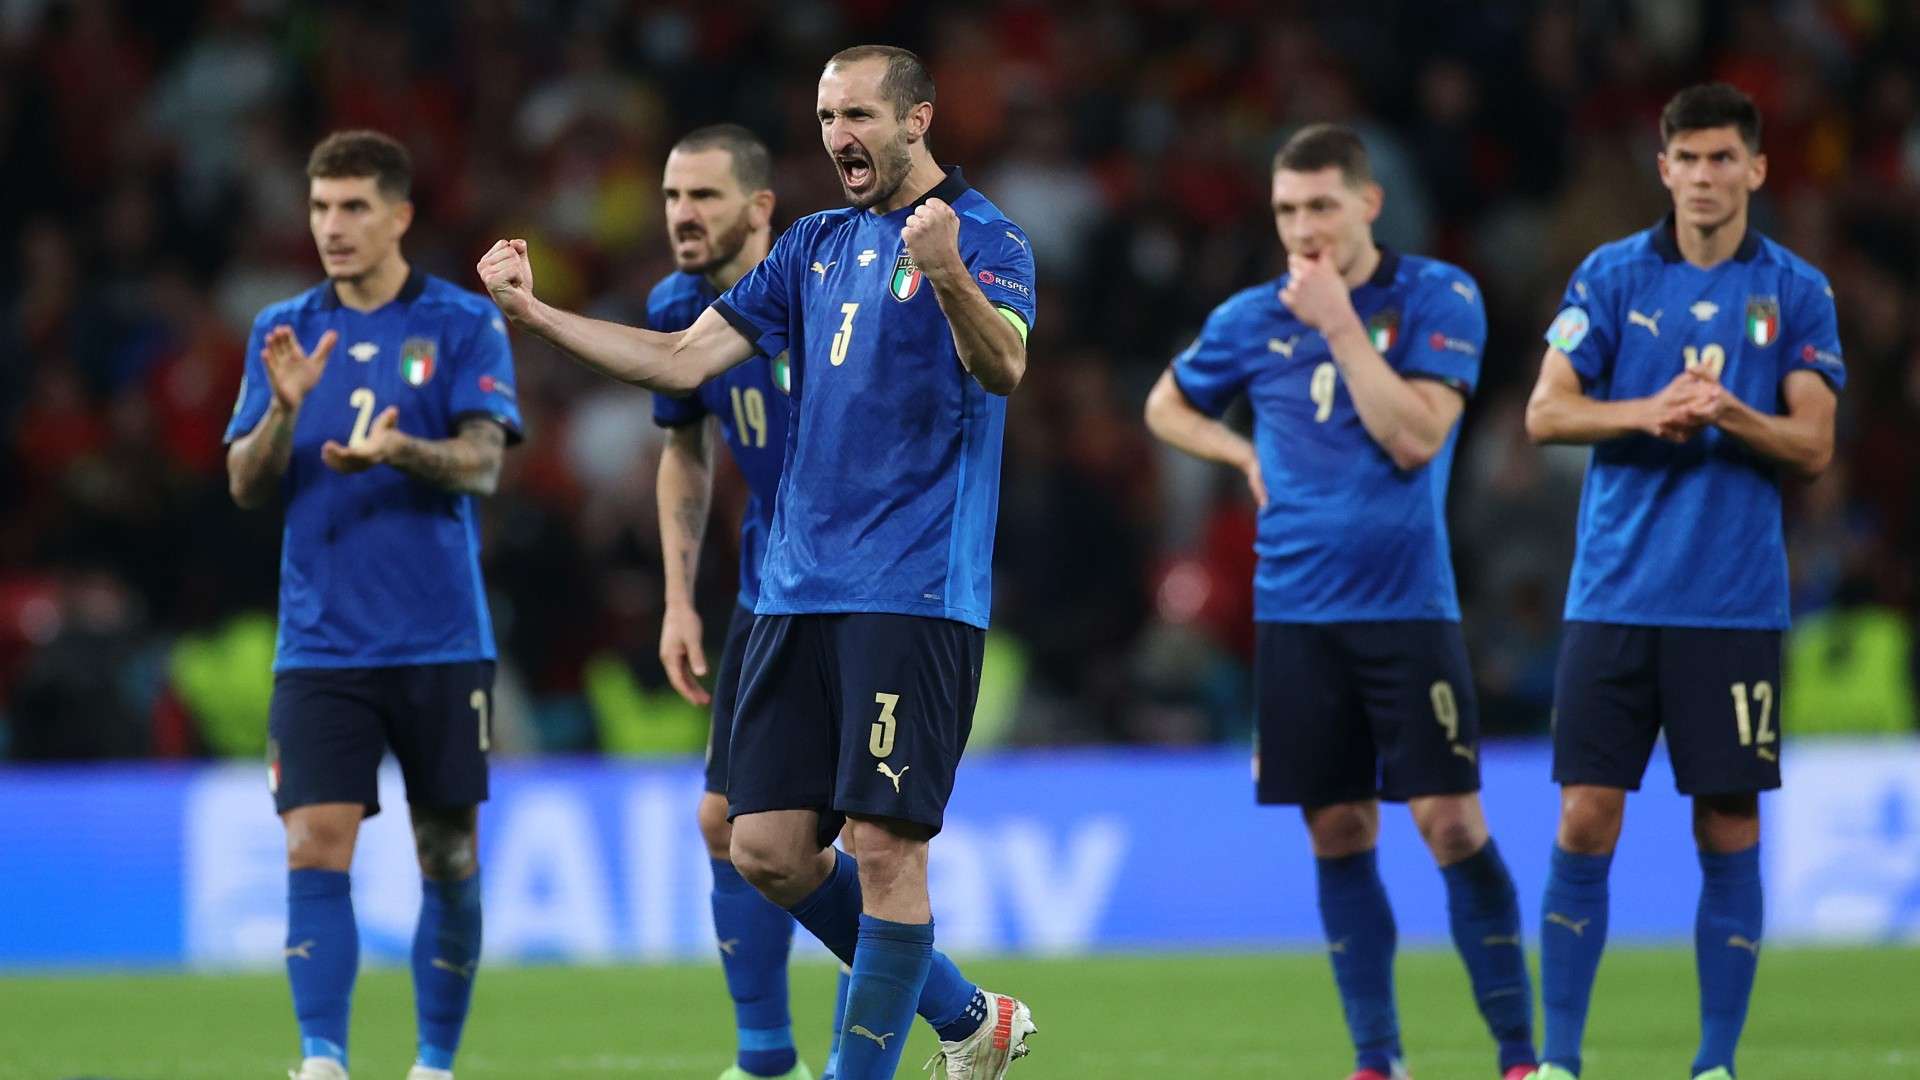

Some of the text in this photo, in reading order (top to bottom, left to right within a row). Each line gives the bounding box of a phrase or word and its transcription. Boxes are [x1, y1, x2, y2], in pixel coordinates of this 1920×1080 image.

[995, 277, 1030, 297] RESPEC
[830, 302, 860, 367] 3
[348, 387, 375, 449] 2
[731, 386, 767, 448] 19
[1310, 361, 1336, 423] 9
[869, 692, 900, 758] 3
[1429, 681, 1458, 741] 9
[1731, 681, 1776, 746] 12
